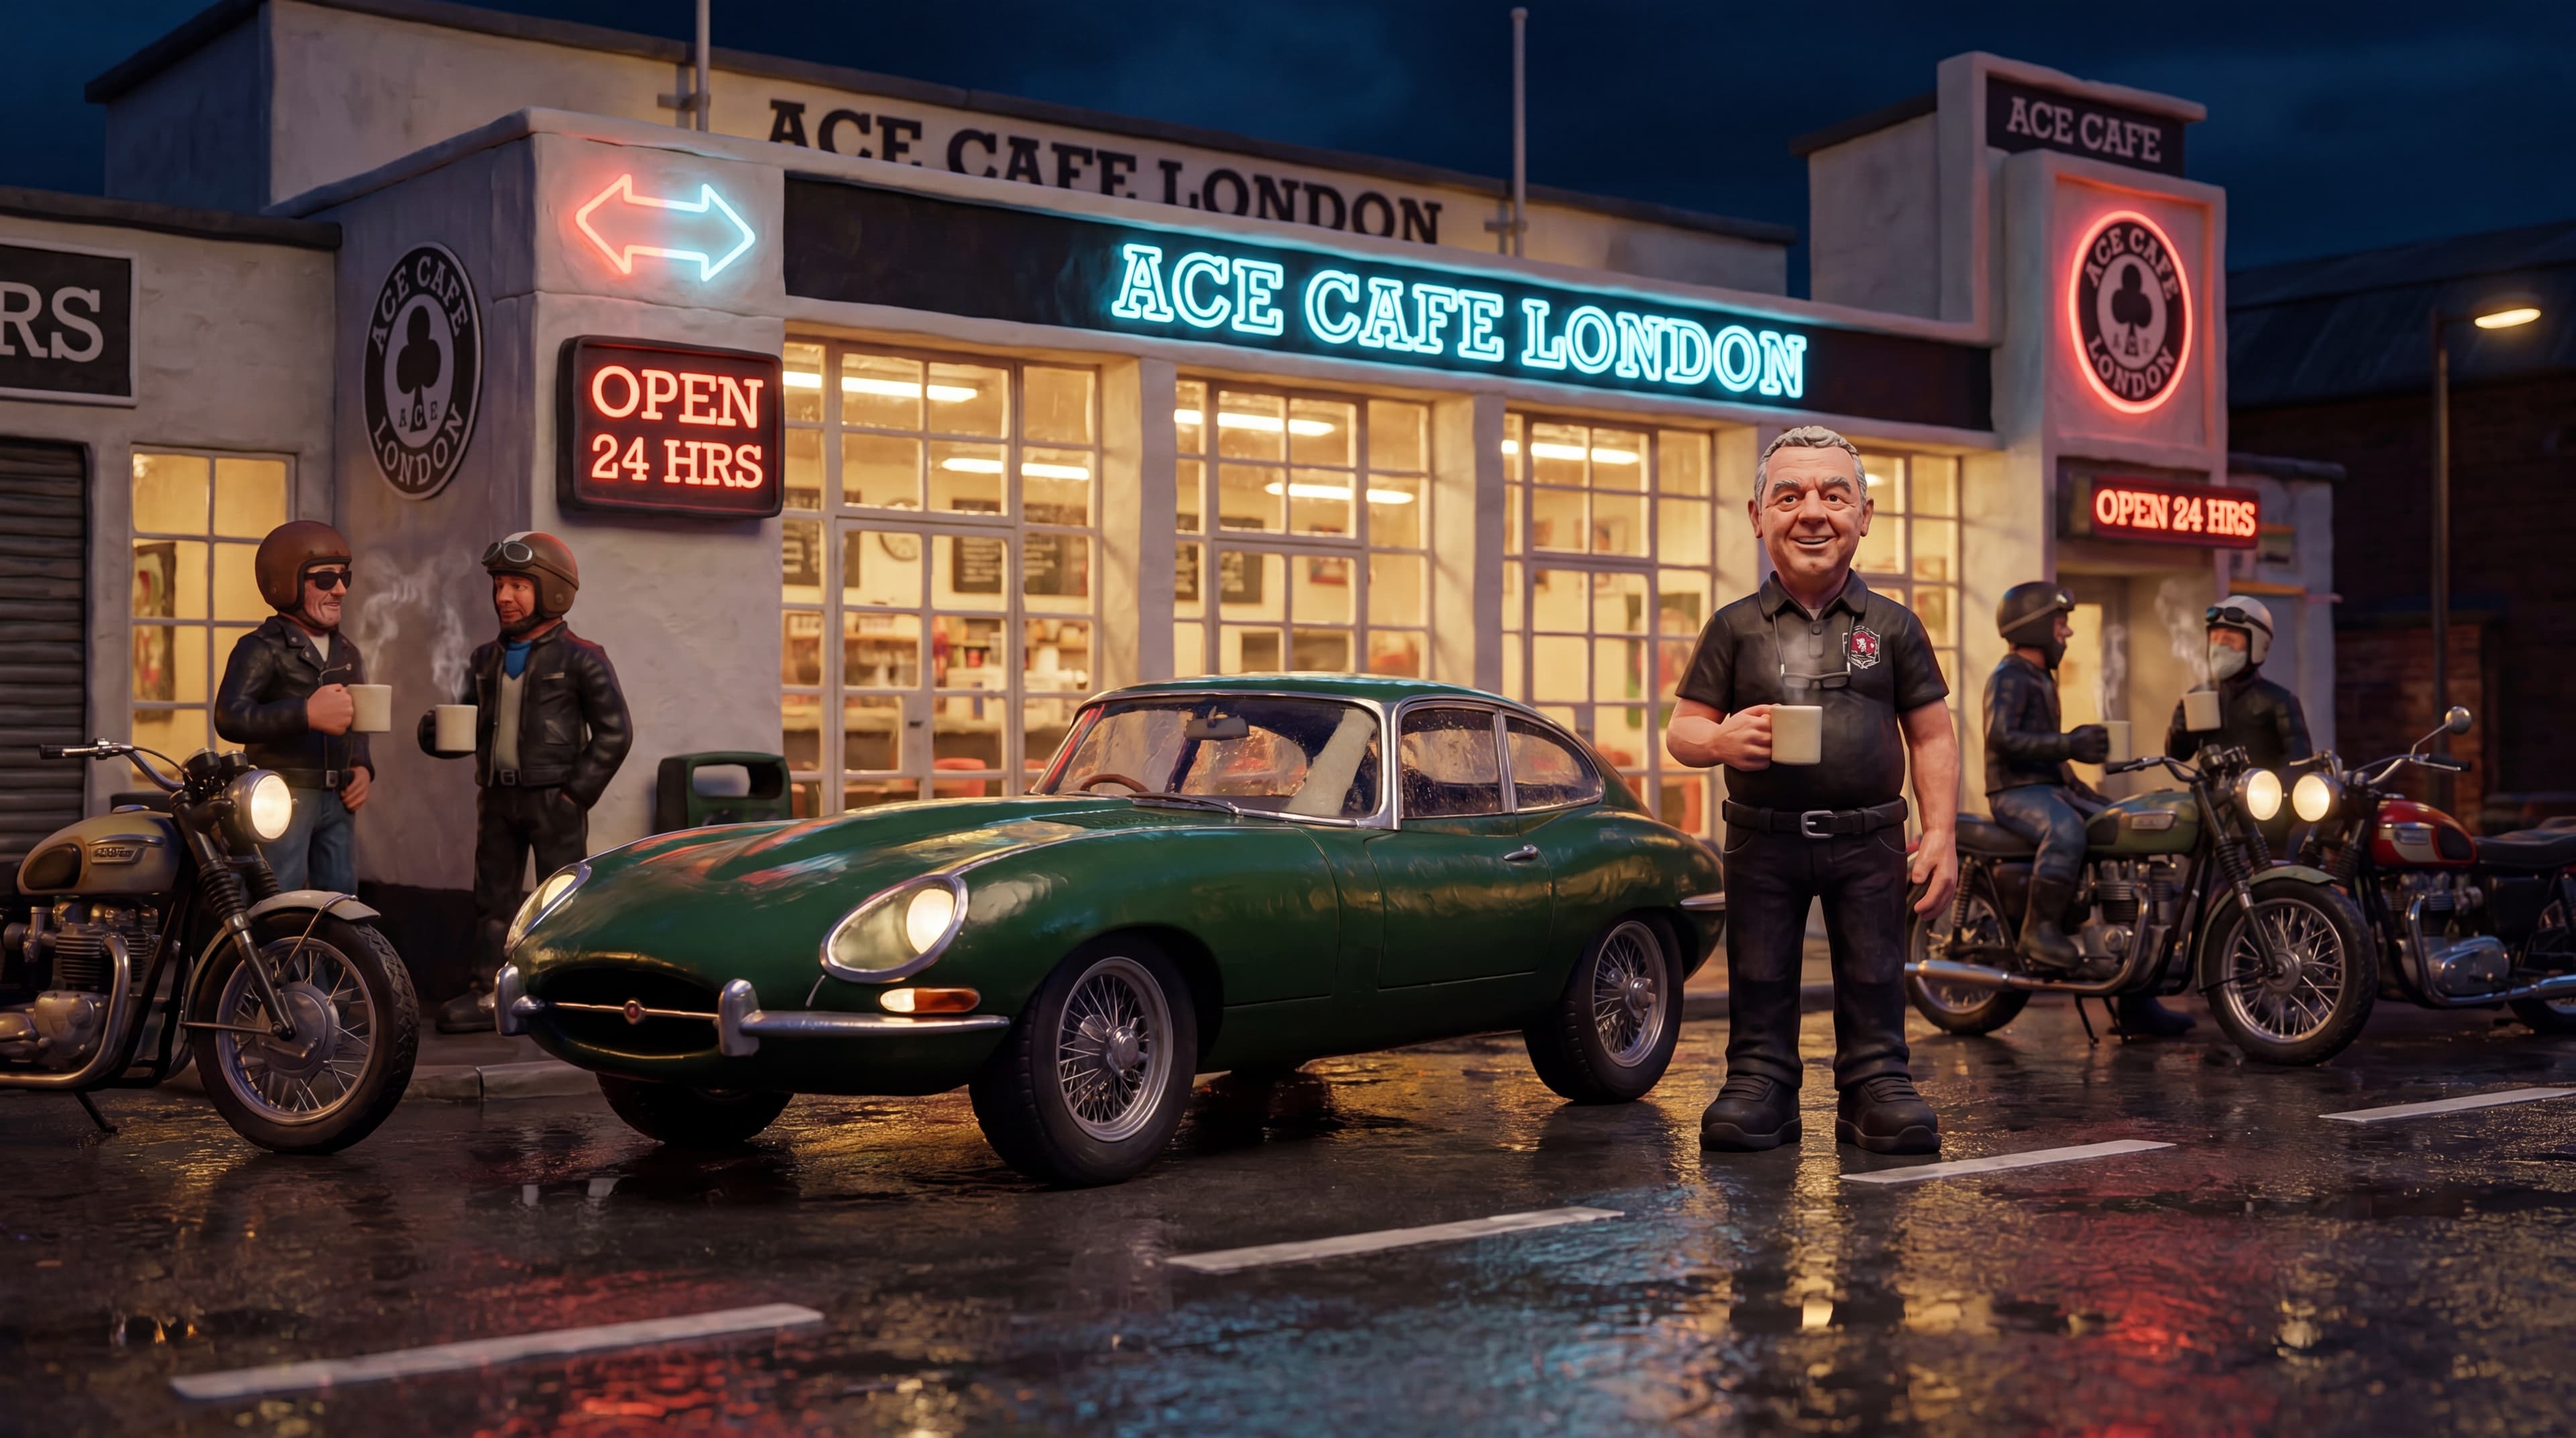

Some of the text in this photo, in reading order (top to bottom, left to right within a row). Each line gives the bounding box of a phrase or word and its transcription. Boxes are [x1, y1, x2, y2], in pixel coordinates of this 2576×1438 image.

[2006, 96, 2161, 163] ACE CAFE
[769, 99, 1442, 245] ACE CAFE LONDON
[2085, 227, 2180, 301] ACE CAFE
[0, 280, 103, 362] RS
[372, 255, 468, 356] ACE CAFE
[1112, 244, 1807, 399] ACE CAFE LONDON
[592, 365, 763, 429] OPEN
[2088, 336, 2175, 399] LONDON
[374, 404, 464, 485] LONDON
[592, 433, 763, 489] 24 HRS
[2096, 489, 2255, 537] OPEN 24 HRS
